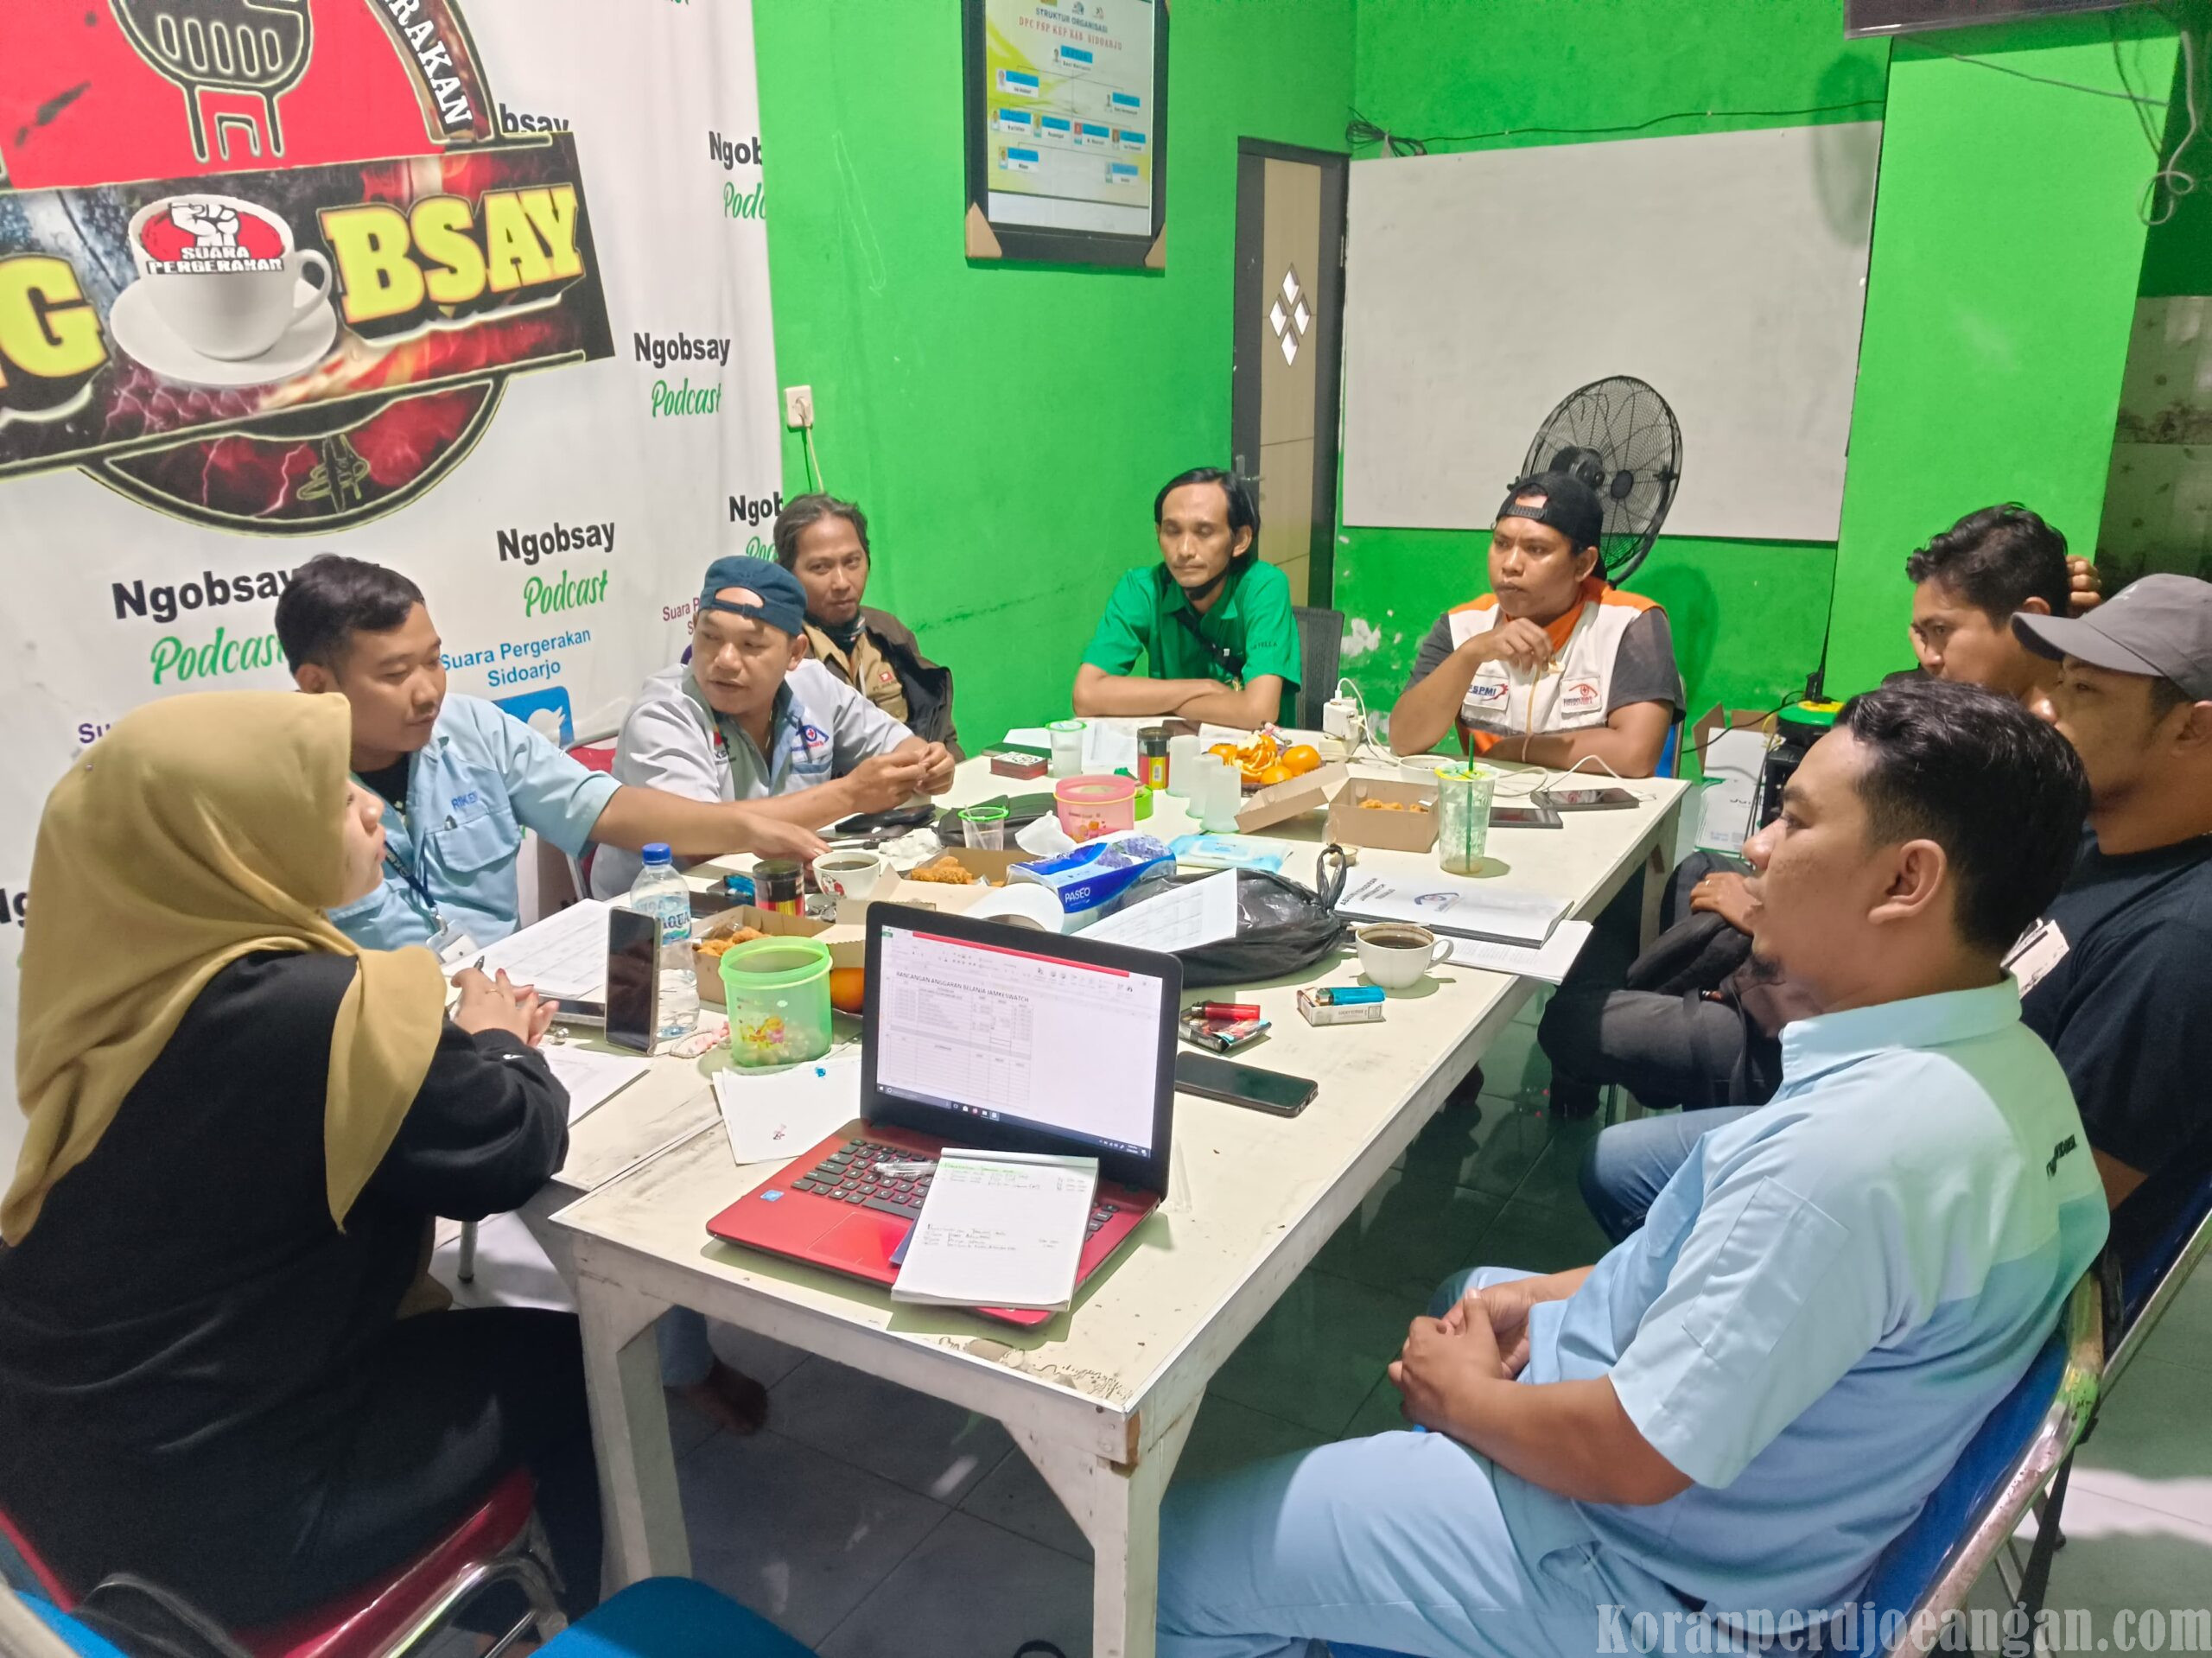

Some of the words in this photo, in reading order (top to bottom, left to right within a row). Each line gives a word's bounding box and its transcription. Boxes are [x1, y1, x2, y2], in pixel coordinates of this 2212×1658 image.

[380, 0, 473, 124] RAKAN
[181, 246, 251, 259] SUARA
[321, 183, 582, 325] BSAY
[634, 333, 730, 368] Ngobsay
[652, 378, 721, 417] Podcast
[497, 523, 614, 565] Ngobsay
[524, 570, 607, 617] Podcast
[663, 603, 690, 621] Suara
[442, 649, 495, 670] Suara
[499, 629, 591, 660] Pergerakan
[487, 659, 561, 687] Sidoarjo
[1065, 886, 1090, 903] PASEO
